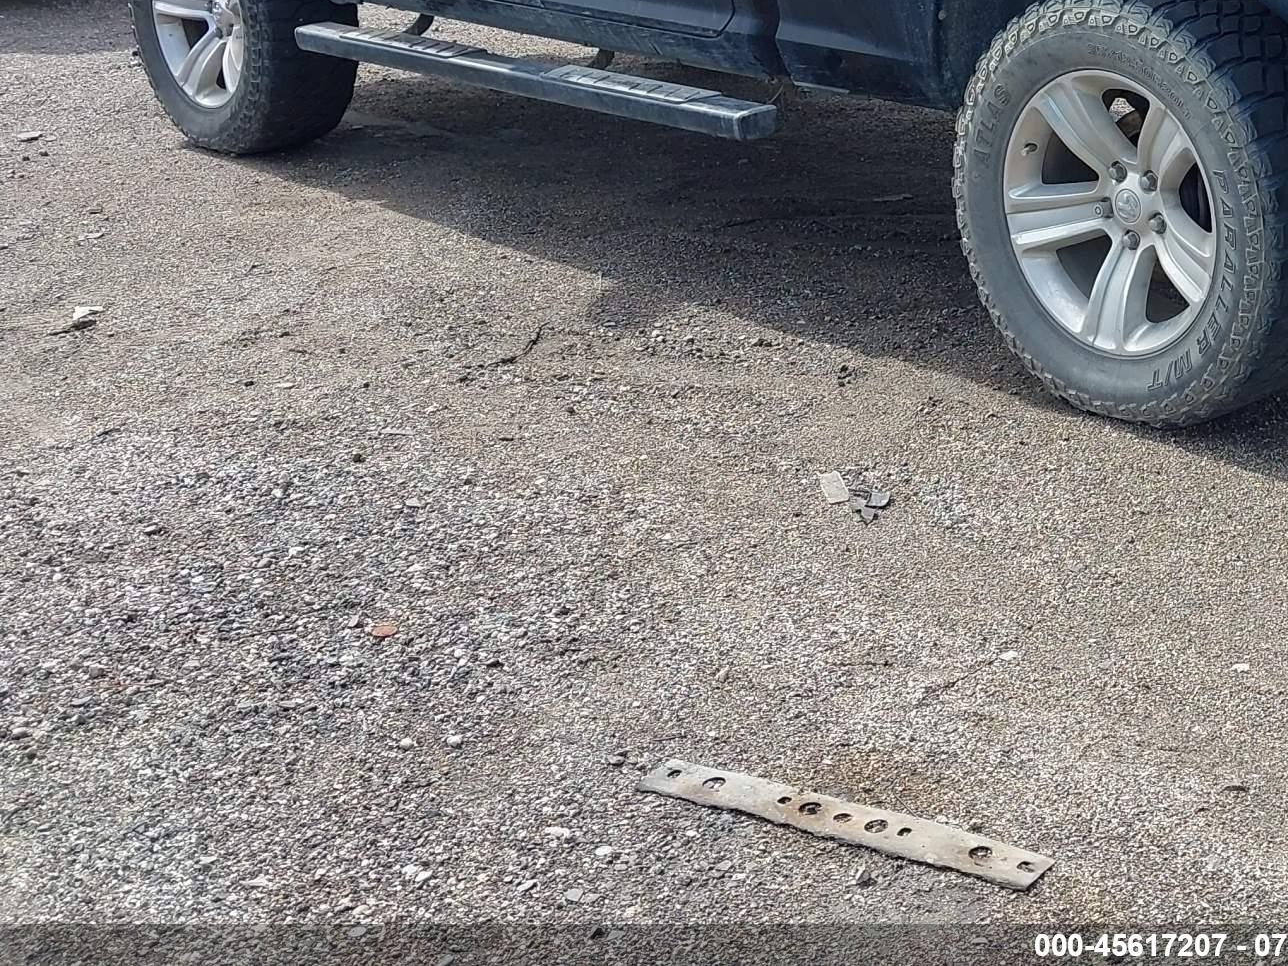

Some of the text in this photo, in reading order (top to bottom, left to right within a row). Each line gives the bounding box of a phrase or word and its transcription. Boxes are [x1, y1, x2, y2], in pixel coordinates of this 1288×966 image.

[974, 83, 1010, 170] ATLAS
[1146, 168, 1238, 392] PARALLER M/T
